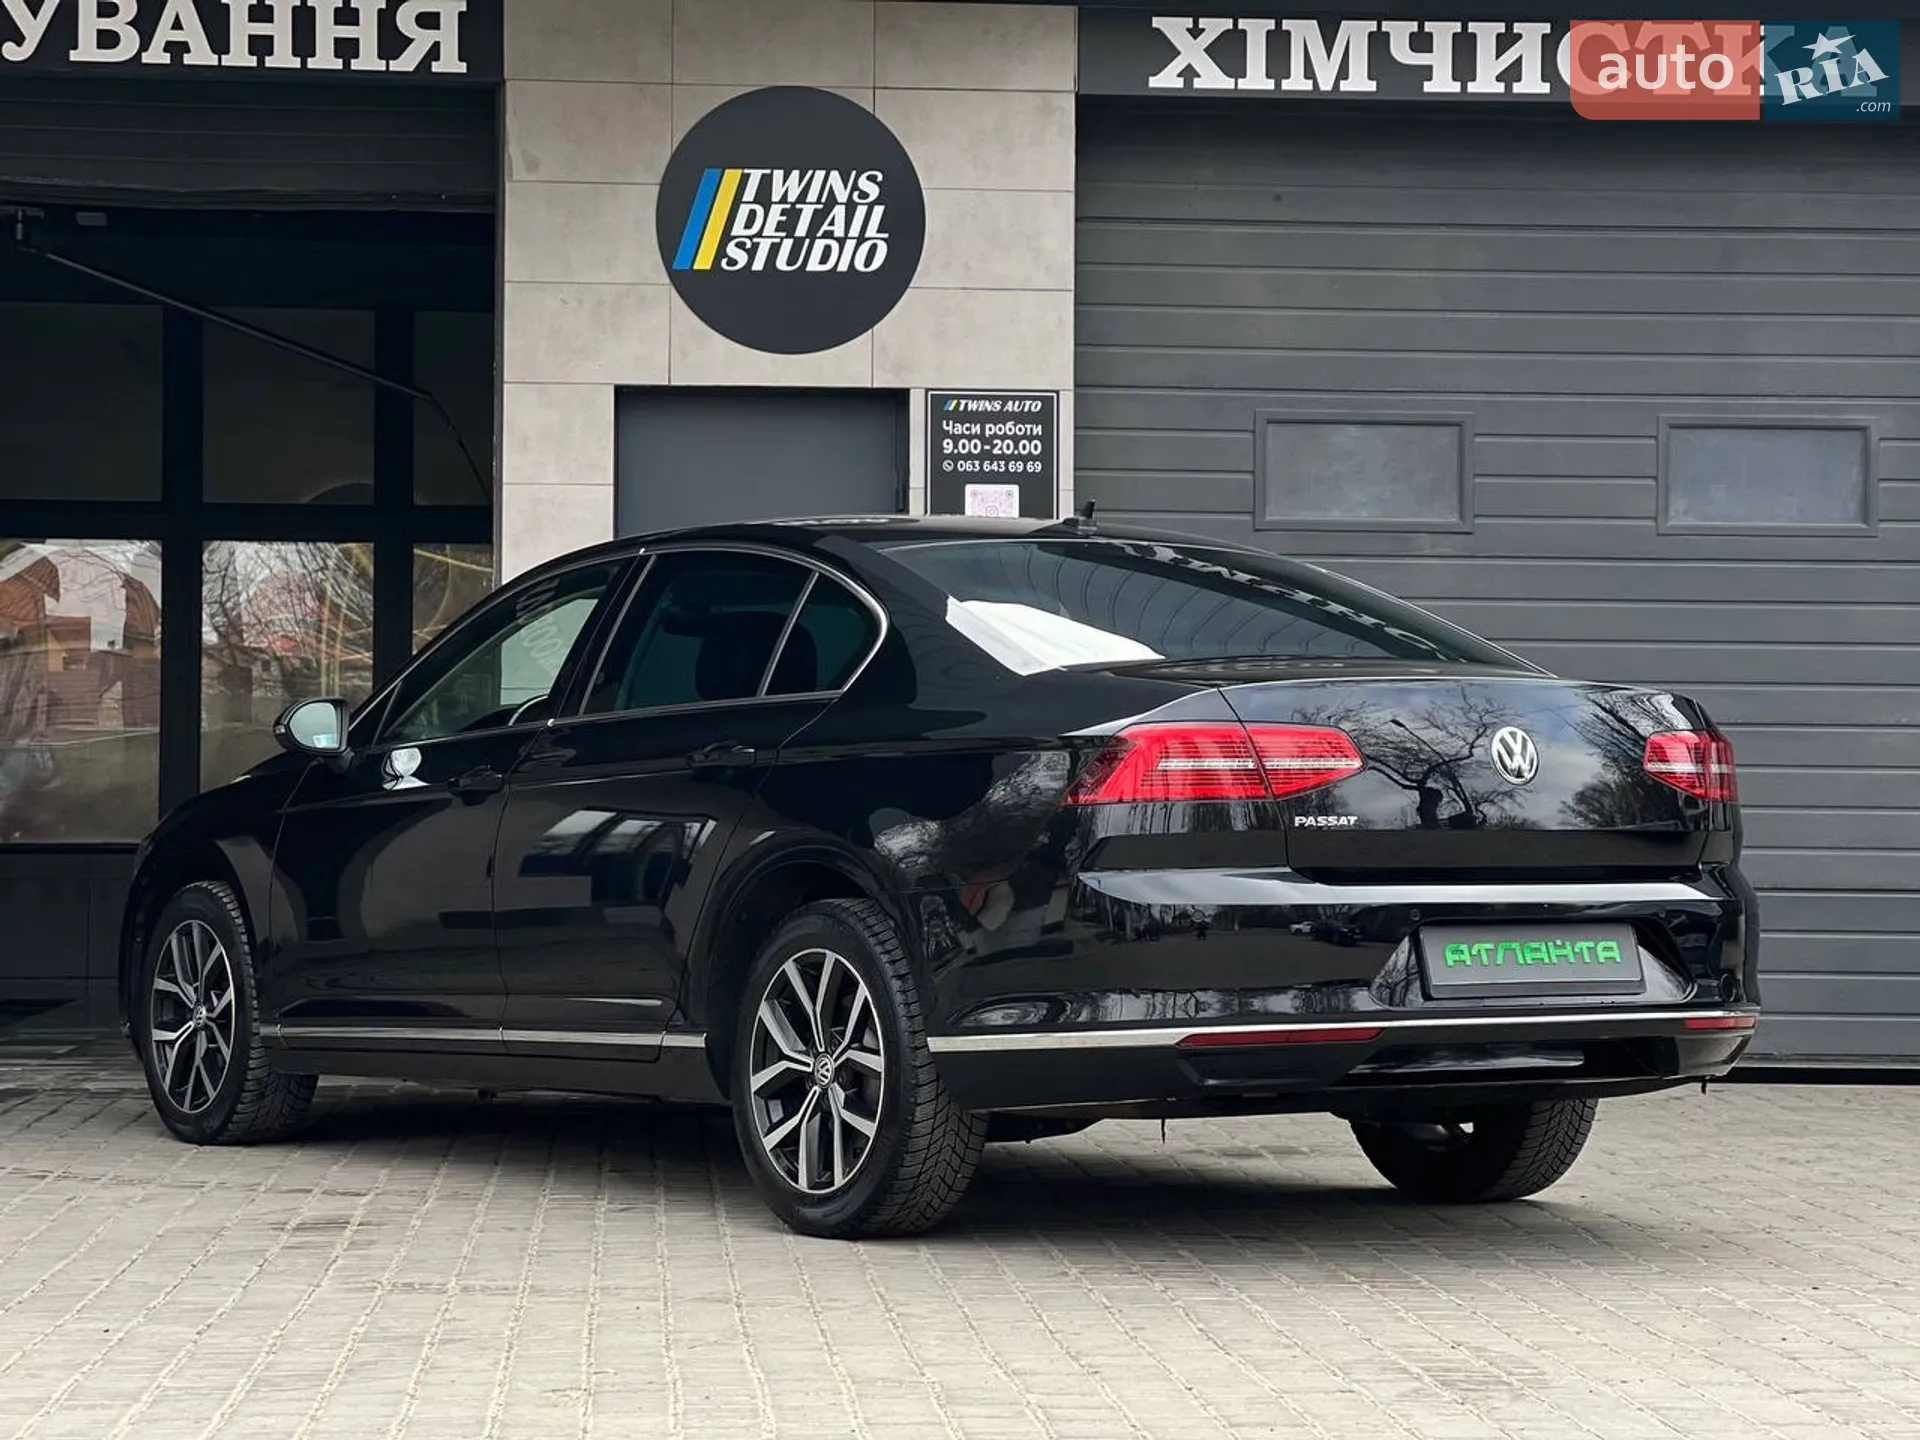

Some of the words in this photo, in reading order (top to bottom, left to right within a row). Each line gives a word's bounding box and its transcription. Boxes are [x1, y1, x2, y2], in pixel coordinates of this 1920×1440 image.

[0, 0, 468, 73] УВАННЯ
[741, 168, 883, 203] TWINS
[730, 203, 889, 238] DETAIL
[720, 237, 889, 272] STUDIO
[958, 399, 1001, 412] TWINS
[1003, 400, 1043, 412] AUTO
[942, 420, 980, 435] Часи
[985, 420, 1043, 437] роботи
[957, 460, 980, 472] 063
[983, 460, 1006, 472] 643
[1008, 460, 1024, 473] 69
[1026, 460, 1043, 473] 69
[1294, 815, 1358, 827] PASSAT
